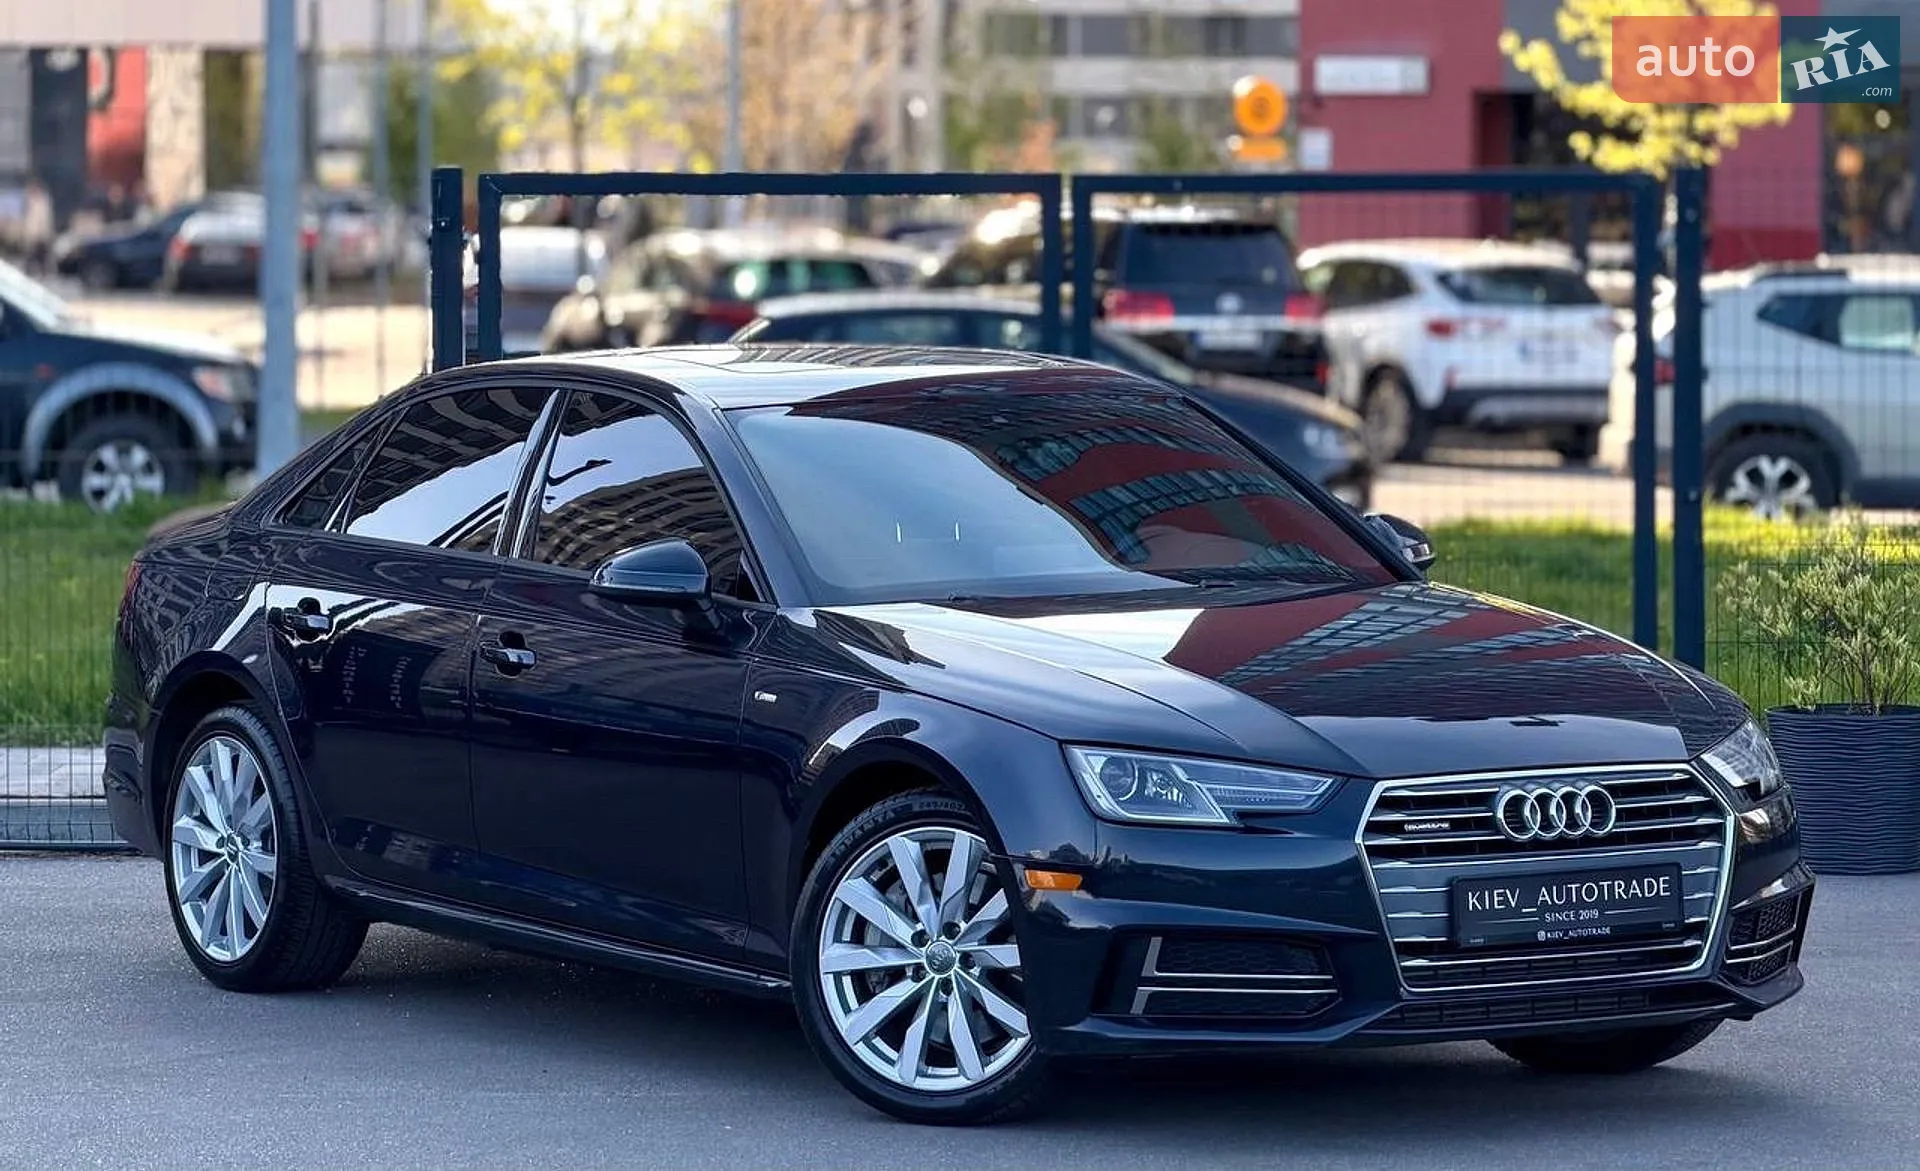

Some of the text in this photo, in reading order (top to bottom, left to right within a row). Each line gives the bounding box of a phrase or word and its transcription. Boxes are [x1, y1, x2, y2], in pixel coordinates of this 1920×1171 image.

[1468, 876, 1671, 912] KIEV_AUTOTRADE
[1545, 909, 1599, 922] SINCE 2019
